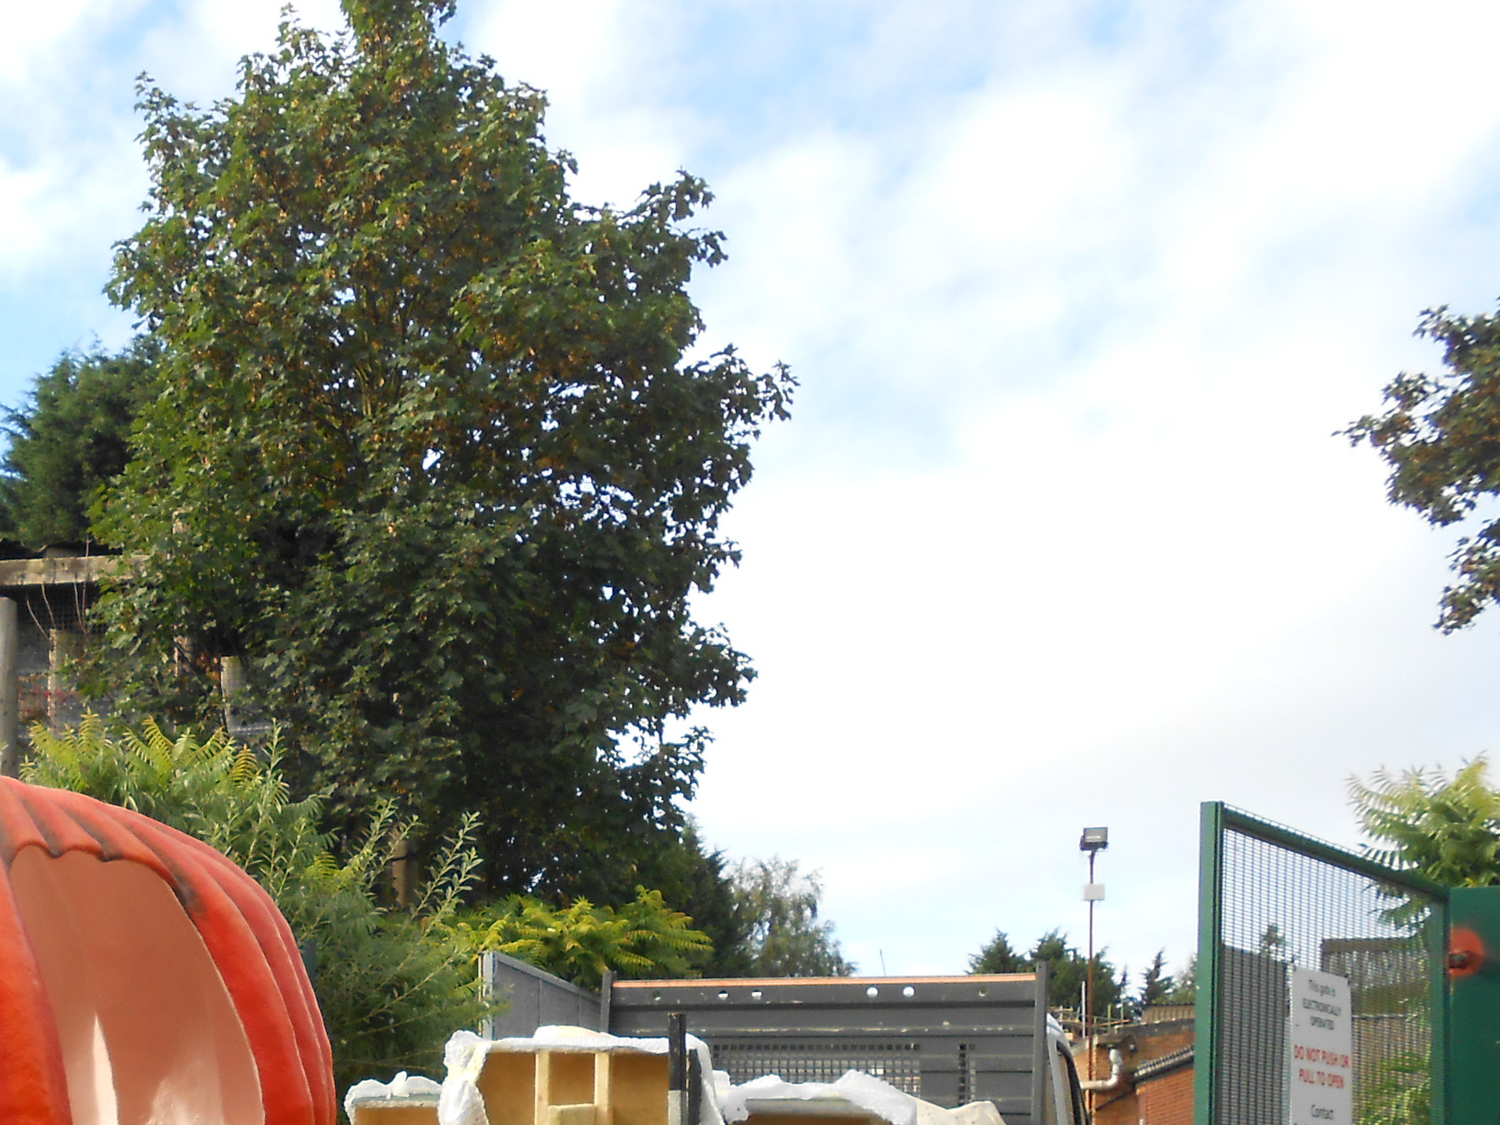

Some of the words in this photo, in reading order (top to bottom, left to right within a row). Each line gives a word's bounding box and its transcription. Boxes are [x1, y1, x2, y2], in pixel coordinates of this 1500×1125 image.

[1294, 1044, 1304, 1060] DO
[1306, 1047, 1321, 1063] NOT
[1322, 1050, 1338, 1066] PUSH
[1340, 1054, 1351, 1069] OR
[1299, 1068, 1316, 1085] PULL
[1317, 1071, 1326, 1086] TO
[1328, 1073, 1345, 1089] OPEN
[1311, 1104, 1334, 1121] Contact
